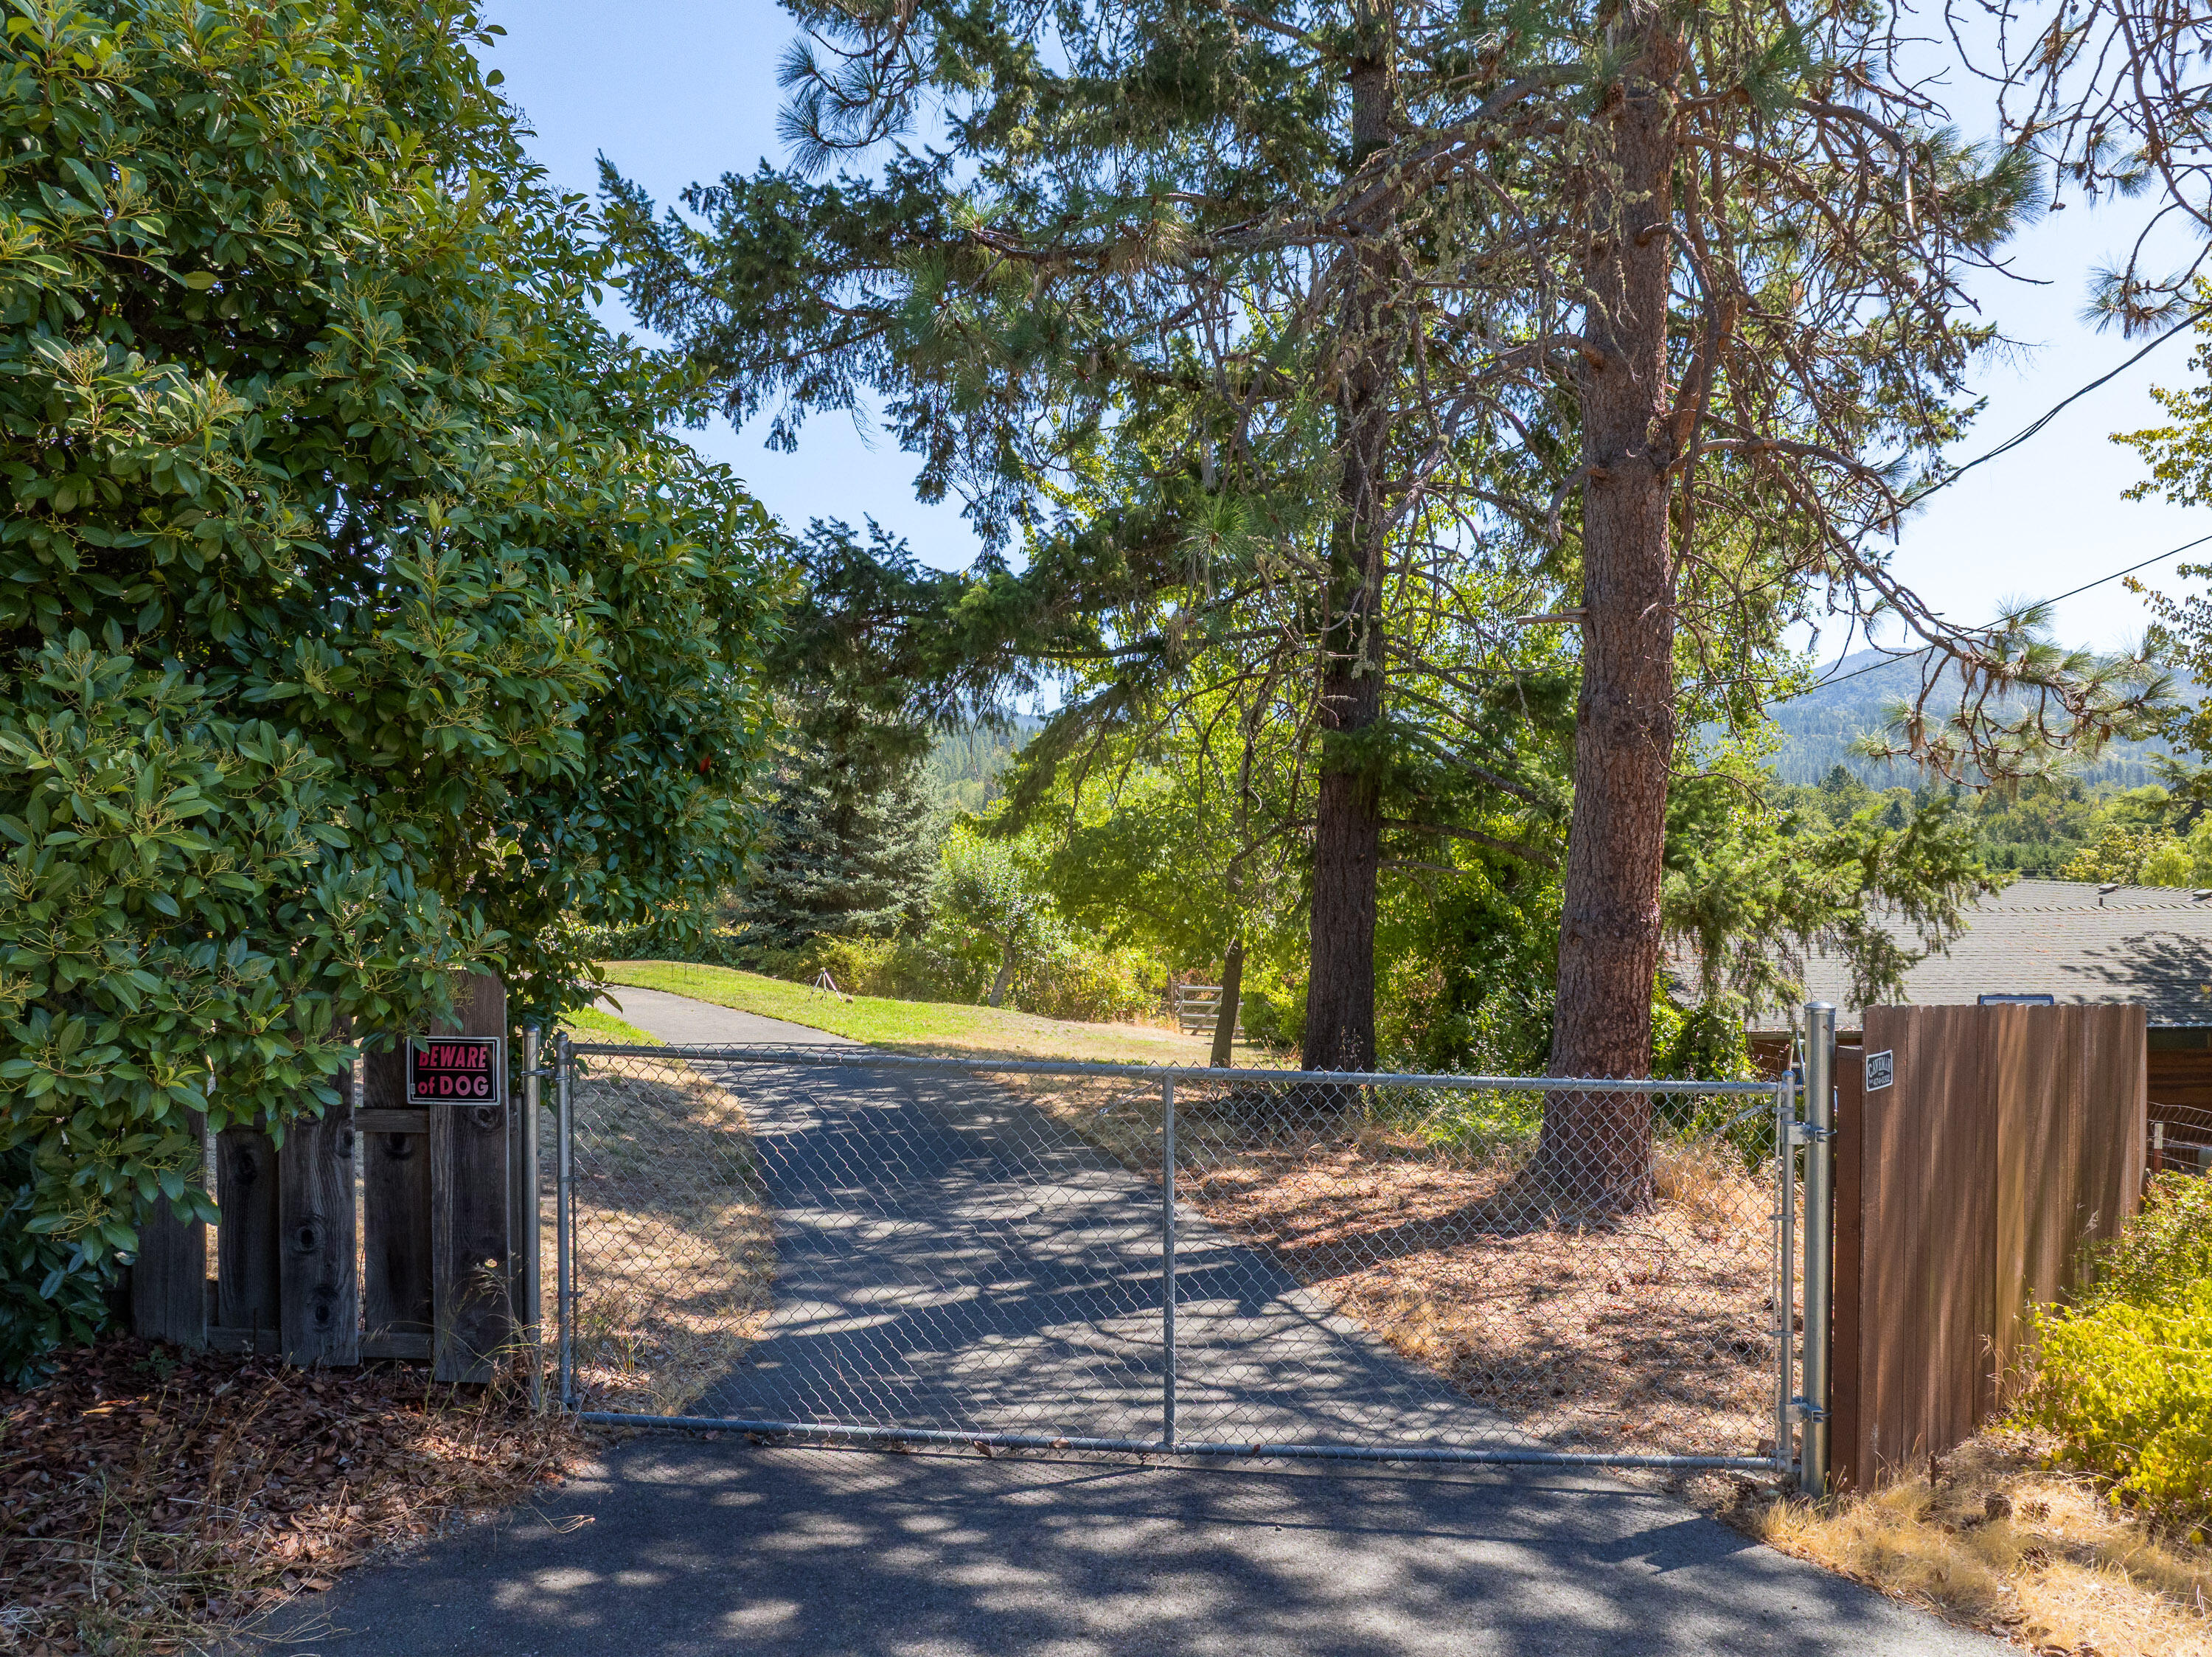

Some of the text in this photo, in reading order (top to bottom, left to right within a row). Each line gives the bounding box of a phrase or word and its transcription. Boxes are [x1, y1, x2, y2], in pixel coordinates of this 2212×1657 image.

[419, 1046, 487, 1068] BEWARE
[1868, 1056, 1891, 1078] CAVEMAN
[418, 1077, 435, 1094] of
[439, 1076, 489, 1096] DOG
